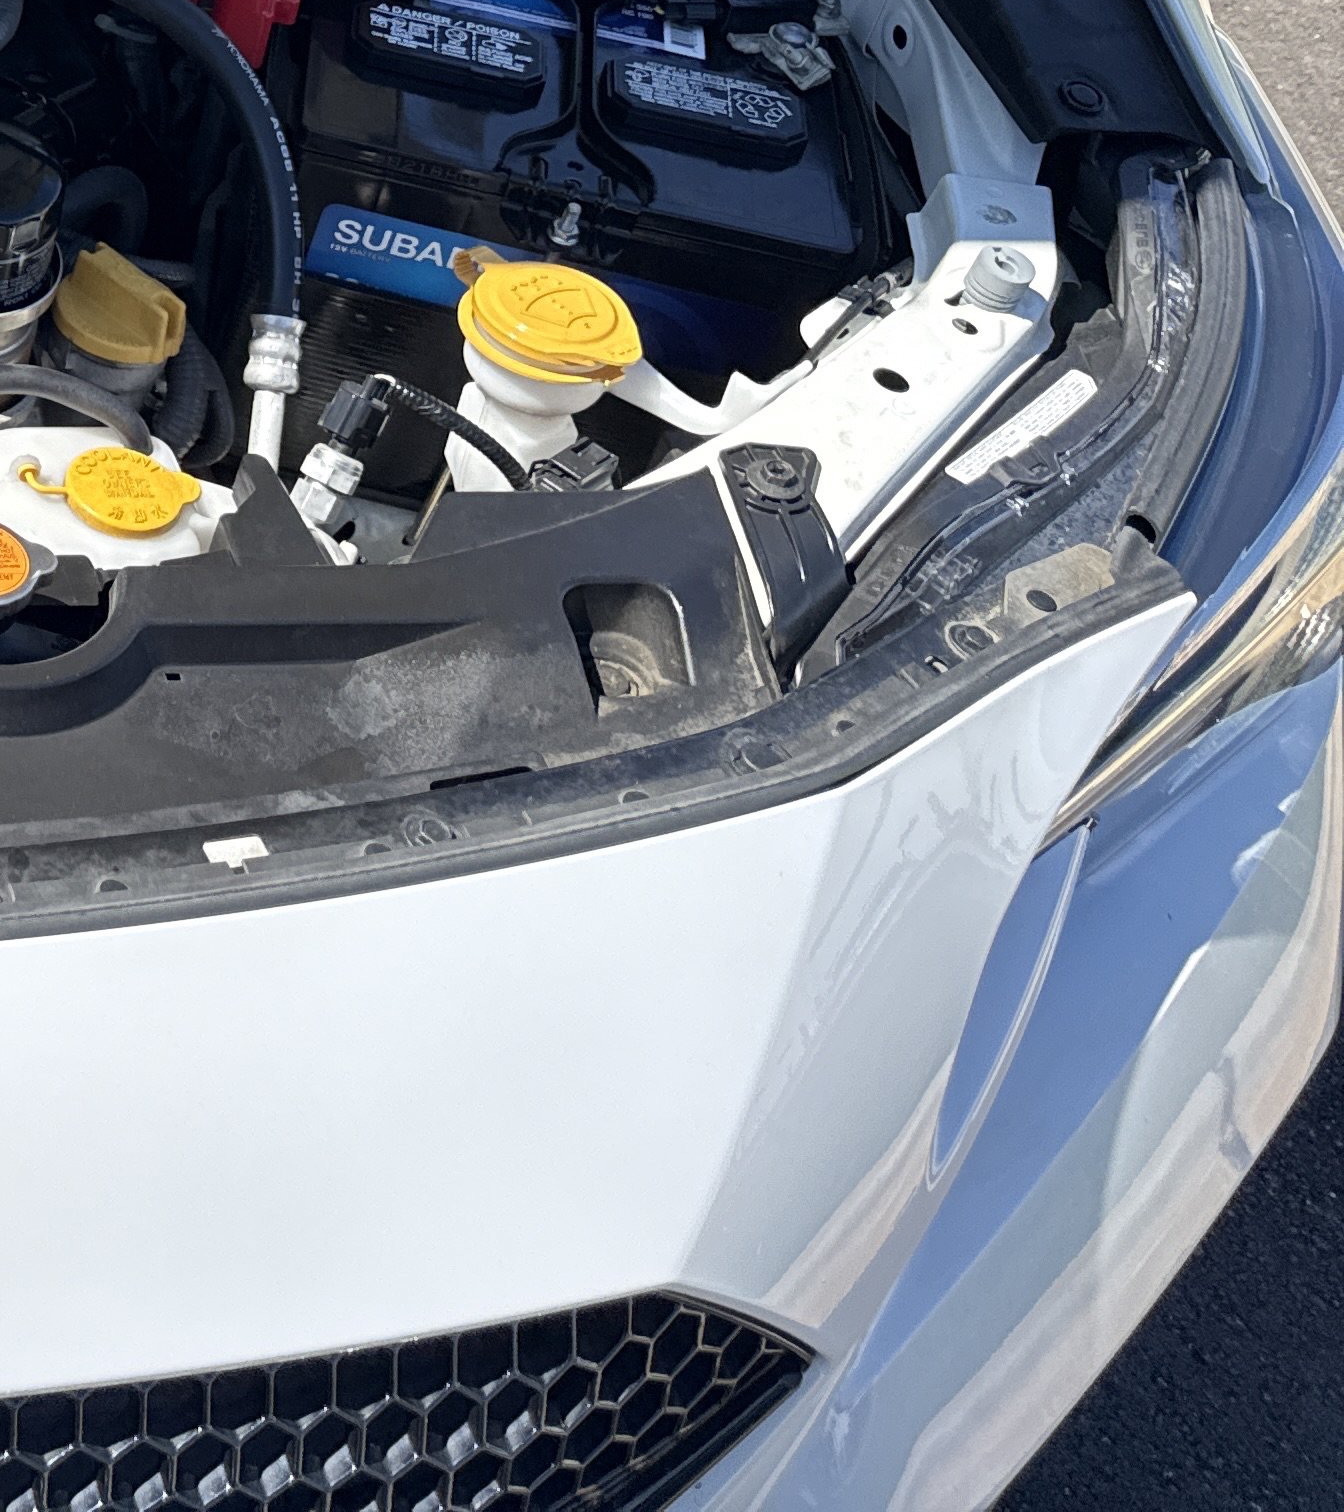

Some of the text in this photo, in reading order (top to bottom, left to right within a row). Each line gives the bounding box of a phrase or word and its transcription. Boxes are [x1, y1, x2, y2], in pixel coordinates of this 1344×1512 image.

[392, 6, 452, 25] DANGER
[466, 21, 520, 41] POISON
[292, 211, 302, 238] HP
[75, 450, 160, 475] COOLANT
